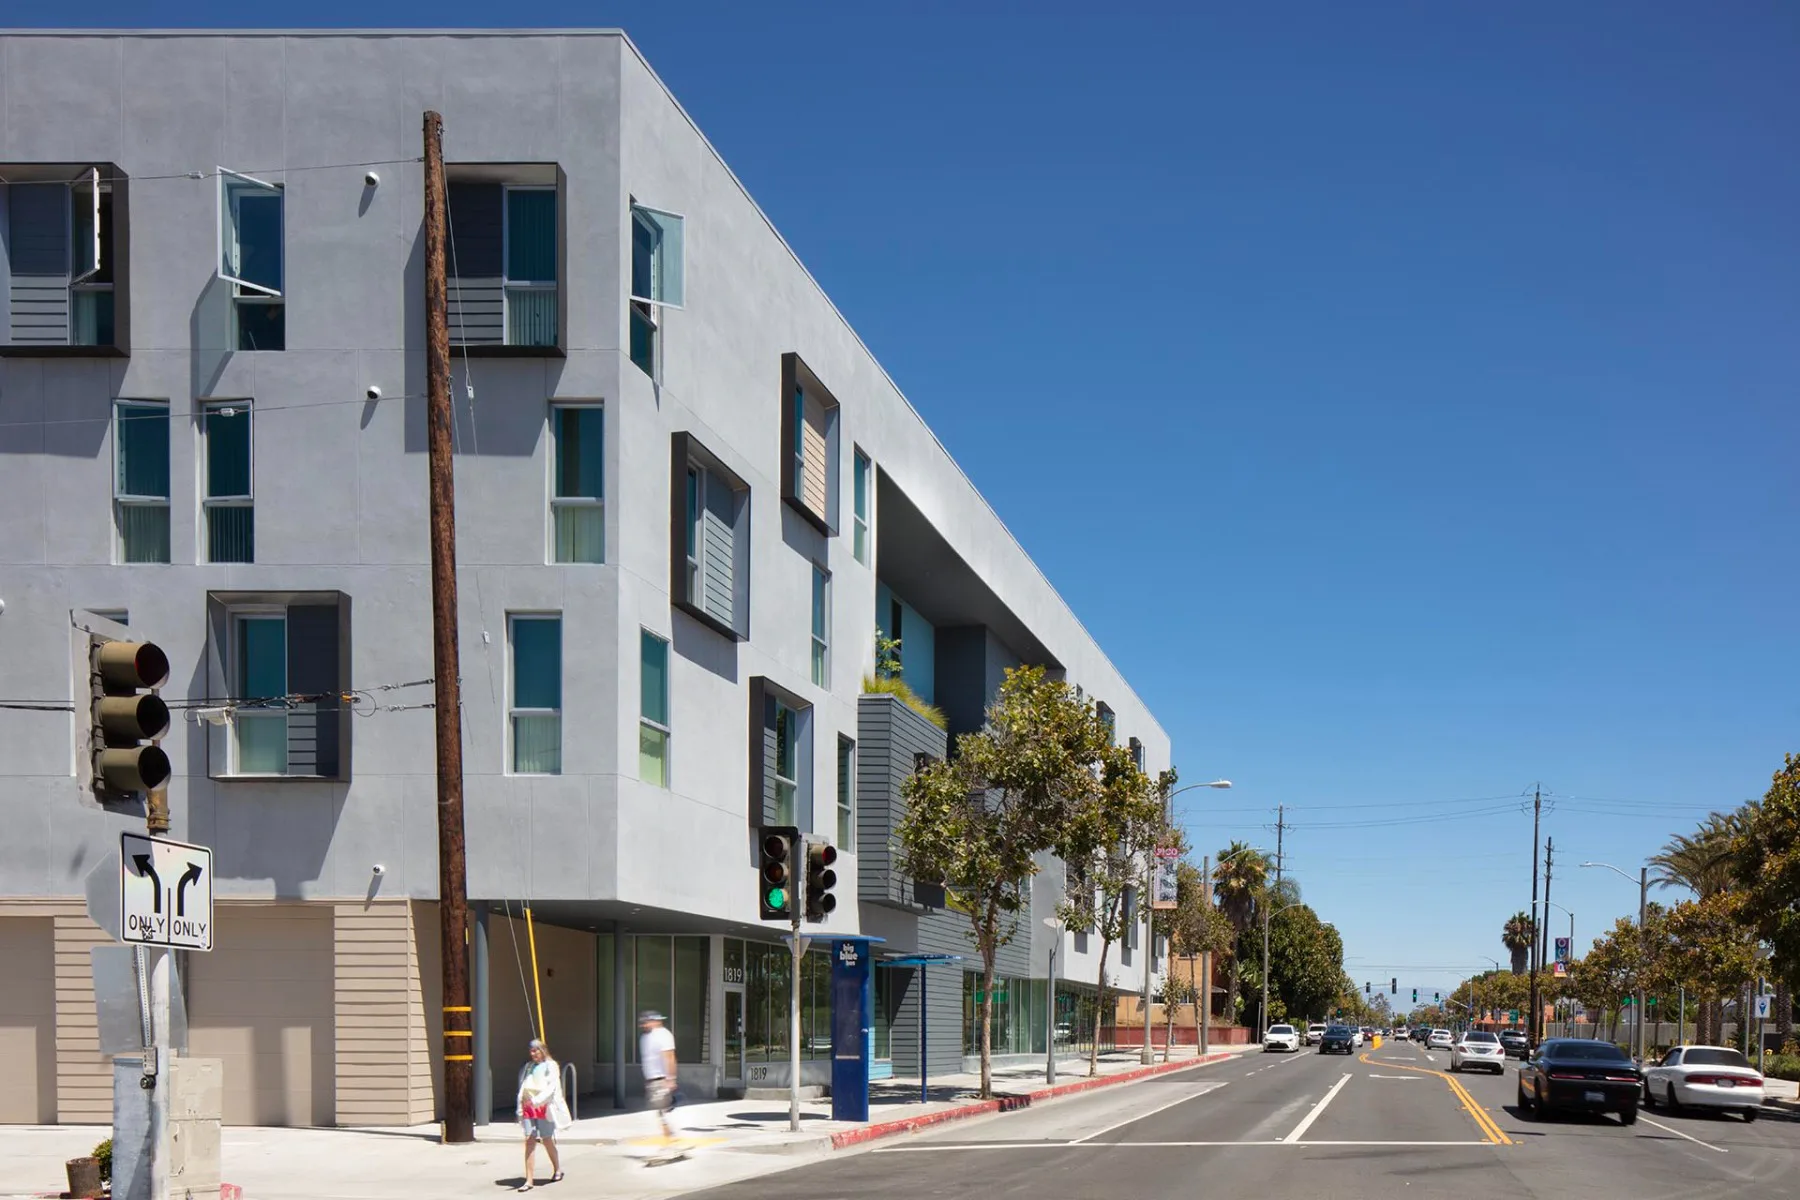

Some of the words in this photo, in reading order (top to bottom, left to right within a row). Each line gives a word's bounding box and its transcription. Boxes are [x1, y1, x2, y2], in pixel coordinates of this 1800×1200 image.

[129, 914, 165, 934] ONLY
[173, 920, 207, 937] ONLY
[839, 950, 858, 960] blue
[842, 943, 855, 953] big
[724, 967, 742, 982] 1819
[750, 1067, 767, 1081] 1819
